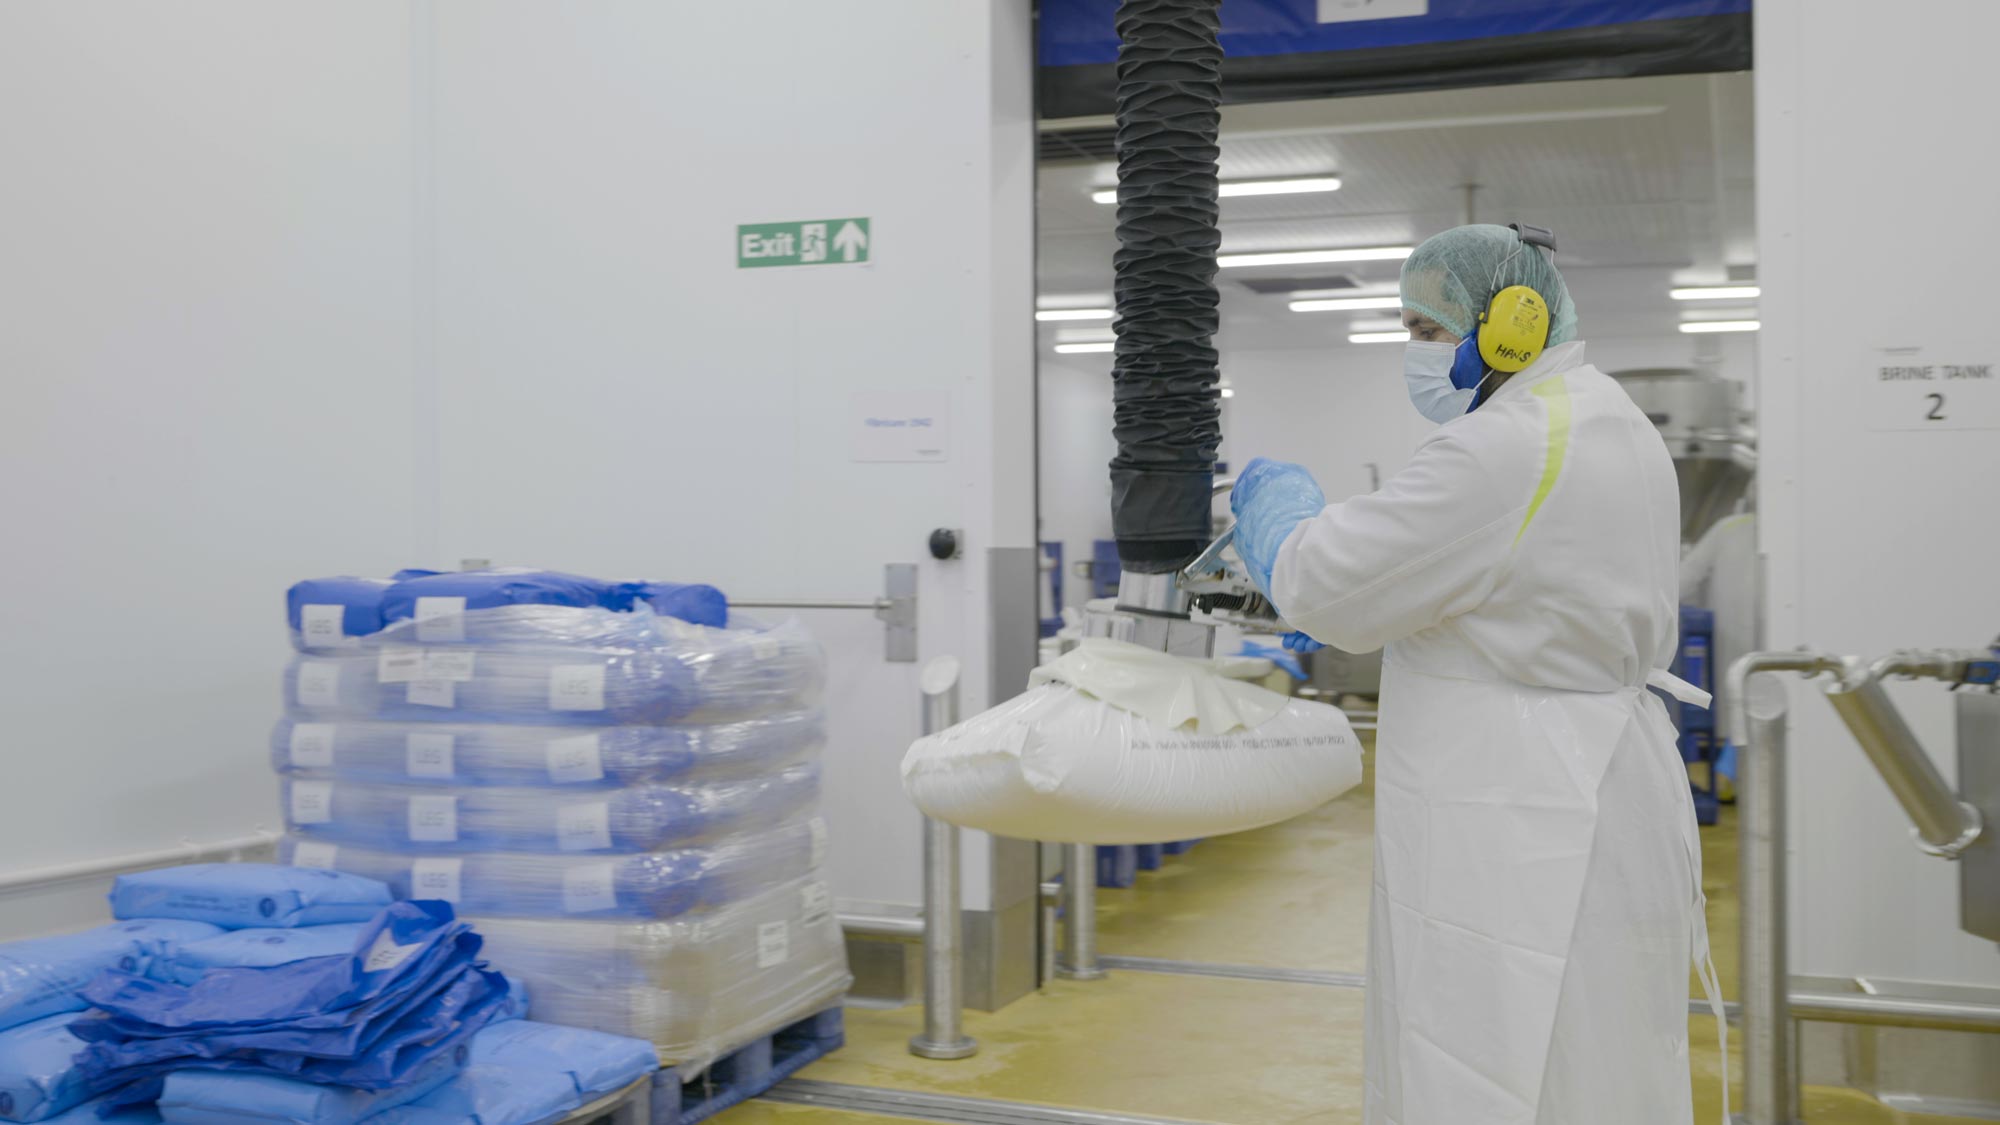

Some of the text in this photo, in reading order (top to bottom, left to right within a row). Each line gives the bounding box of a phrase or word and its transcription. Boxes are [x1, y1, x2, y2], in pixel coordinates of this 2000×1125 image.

[740, 232, 795, 259] Exit
[1494, 343, 1532, 363] HANS
[1879, 364, 1994, 382] BRINE TANK
[1925, 392, 1946, 421] 2
